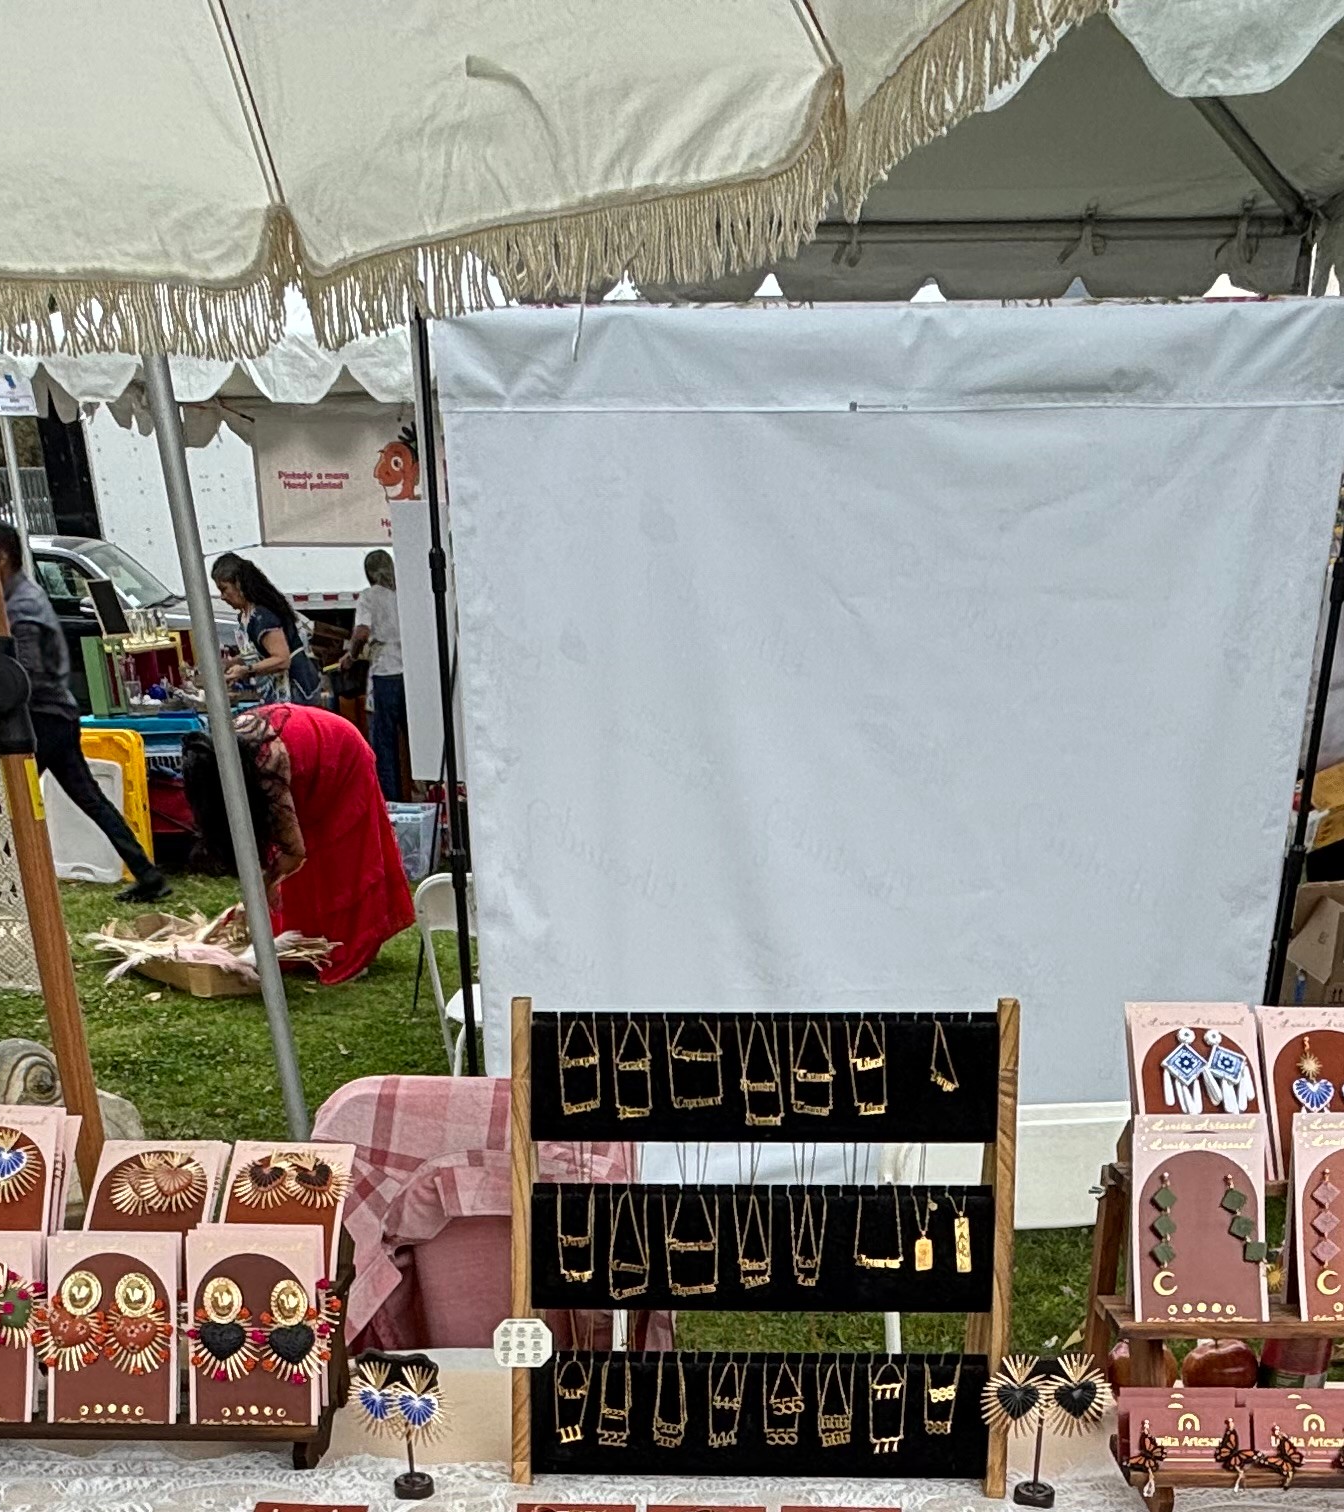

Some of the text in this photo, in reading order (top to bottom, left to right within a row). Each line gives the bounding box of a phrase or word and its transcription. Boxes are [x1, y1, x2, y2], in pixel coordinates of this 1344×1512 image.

[769, 1396, 805, 1416] 555
[560, 1424, 584, 1443] 111
[598, 1431, 628, 1448] 222
[765, 1428, 799, 1446] 555
[1182, 1435, 1222, 1447] Artesan
